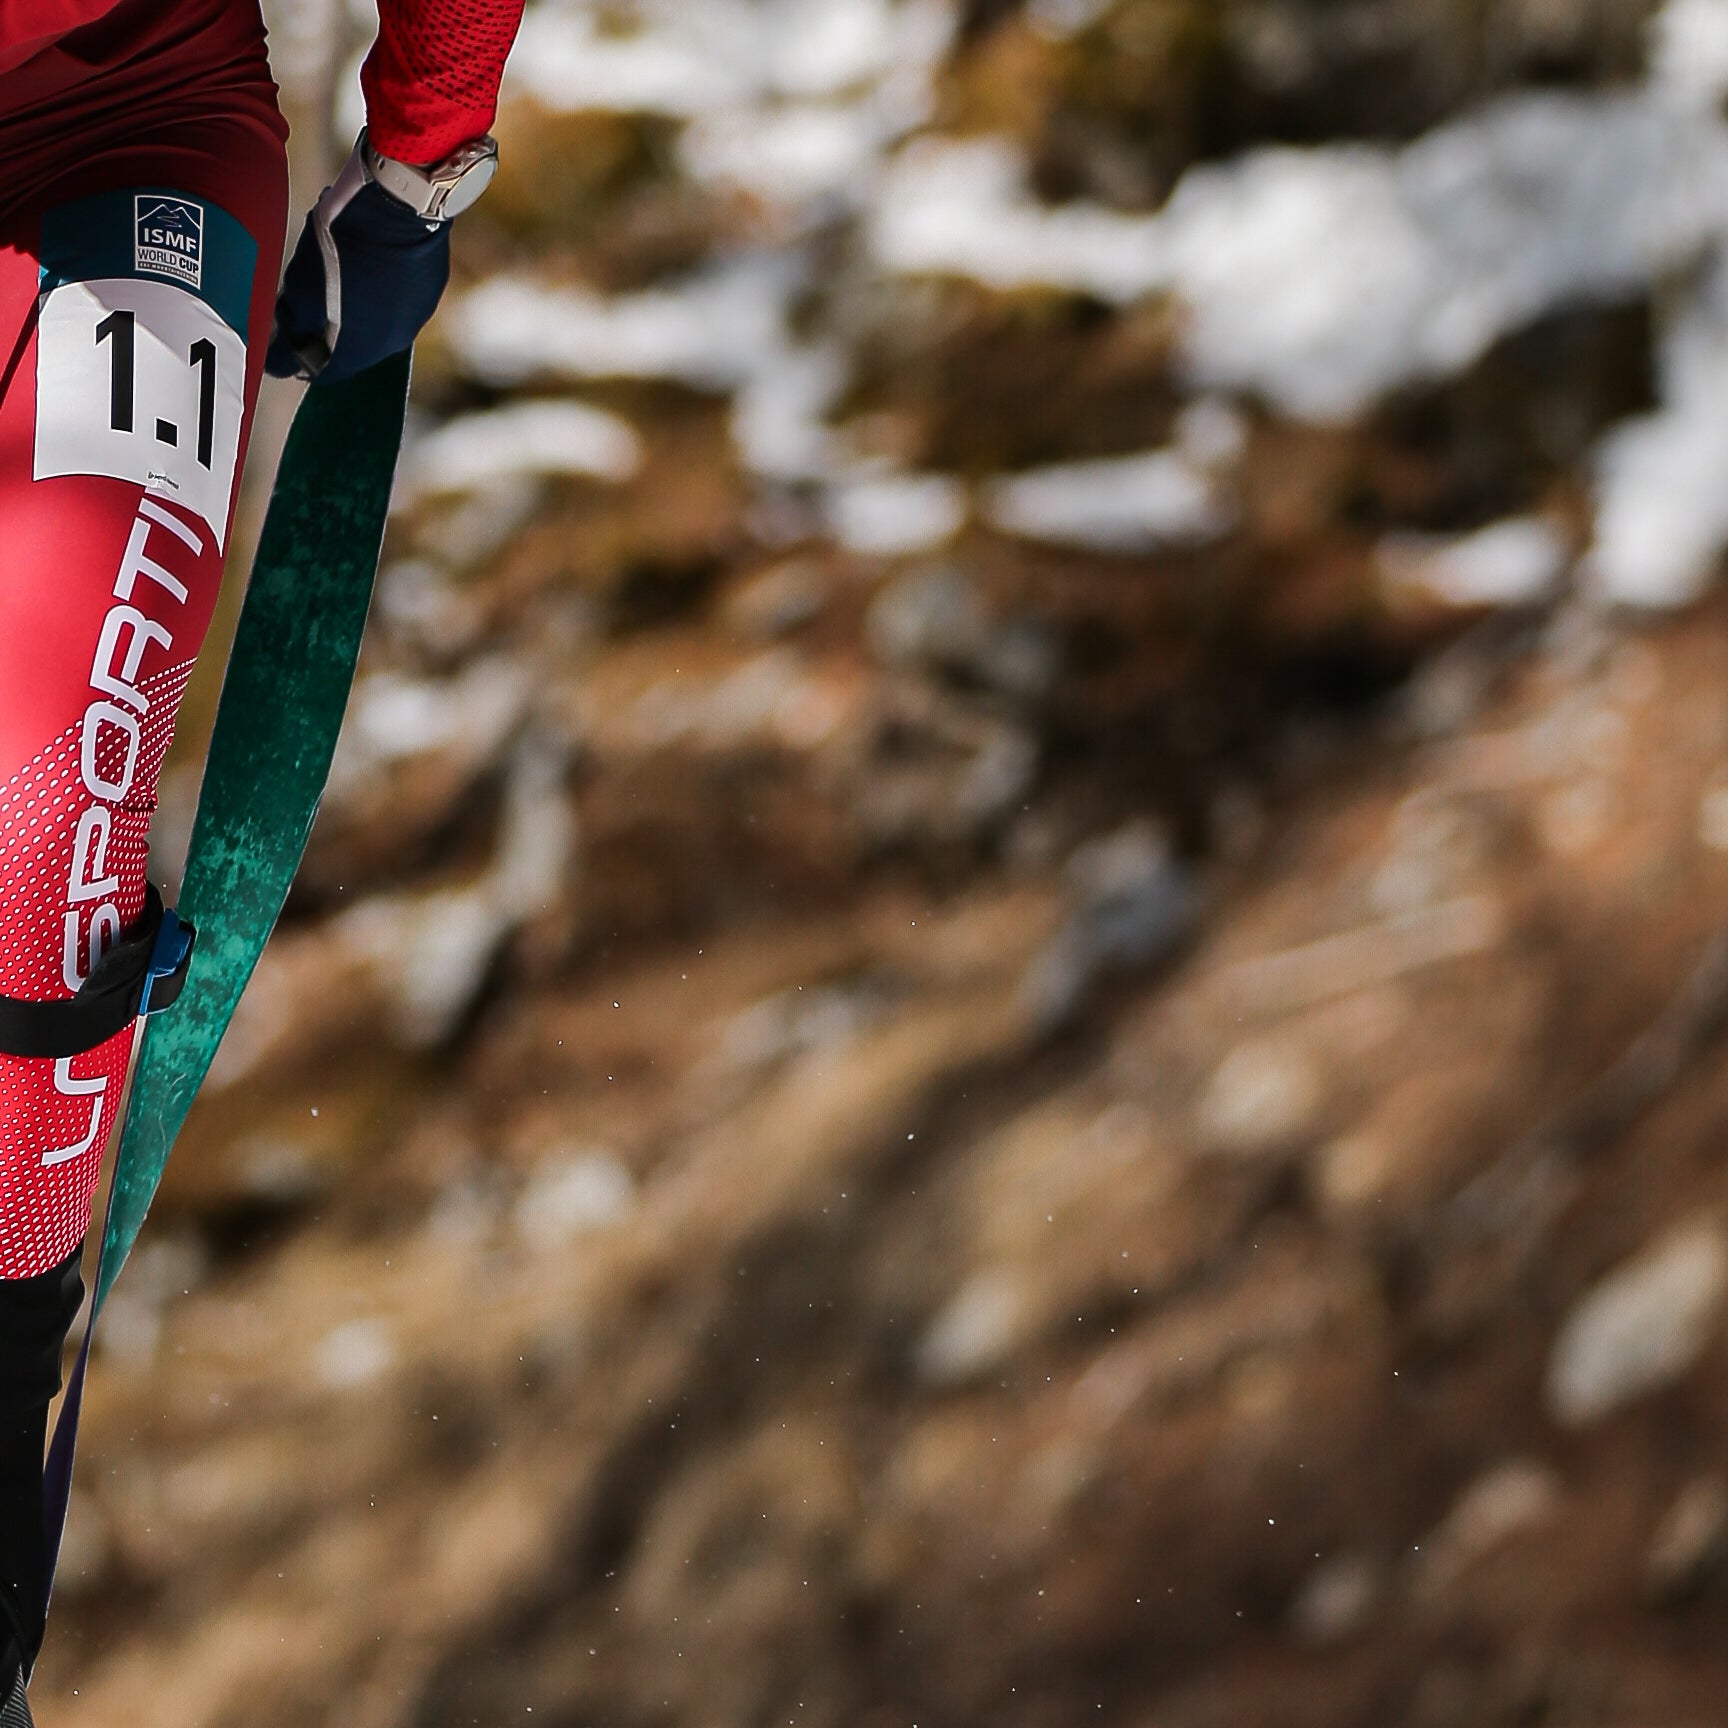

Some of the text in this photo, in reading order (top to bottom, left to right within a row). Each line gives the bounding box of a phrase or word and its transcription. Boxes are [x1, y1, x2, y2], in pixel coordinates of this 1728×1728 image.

[137, 248, 178, 266] WORLD
[178, 256, 200, 274] CUP
[144, 227, 198, 253] ISMF
[95, 310, 217, 472] 1.1
[62, 497, 204, 994] SPORTI
